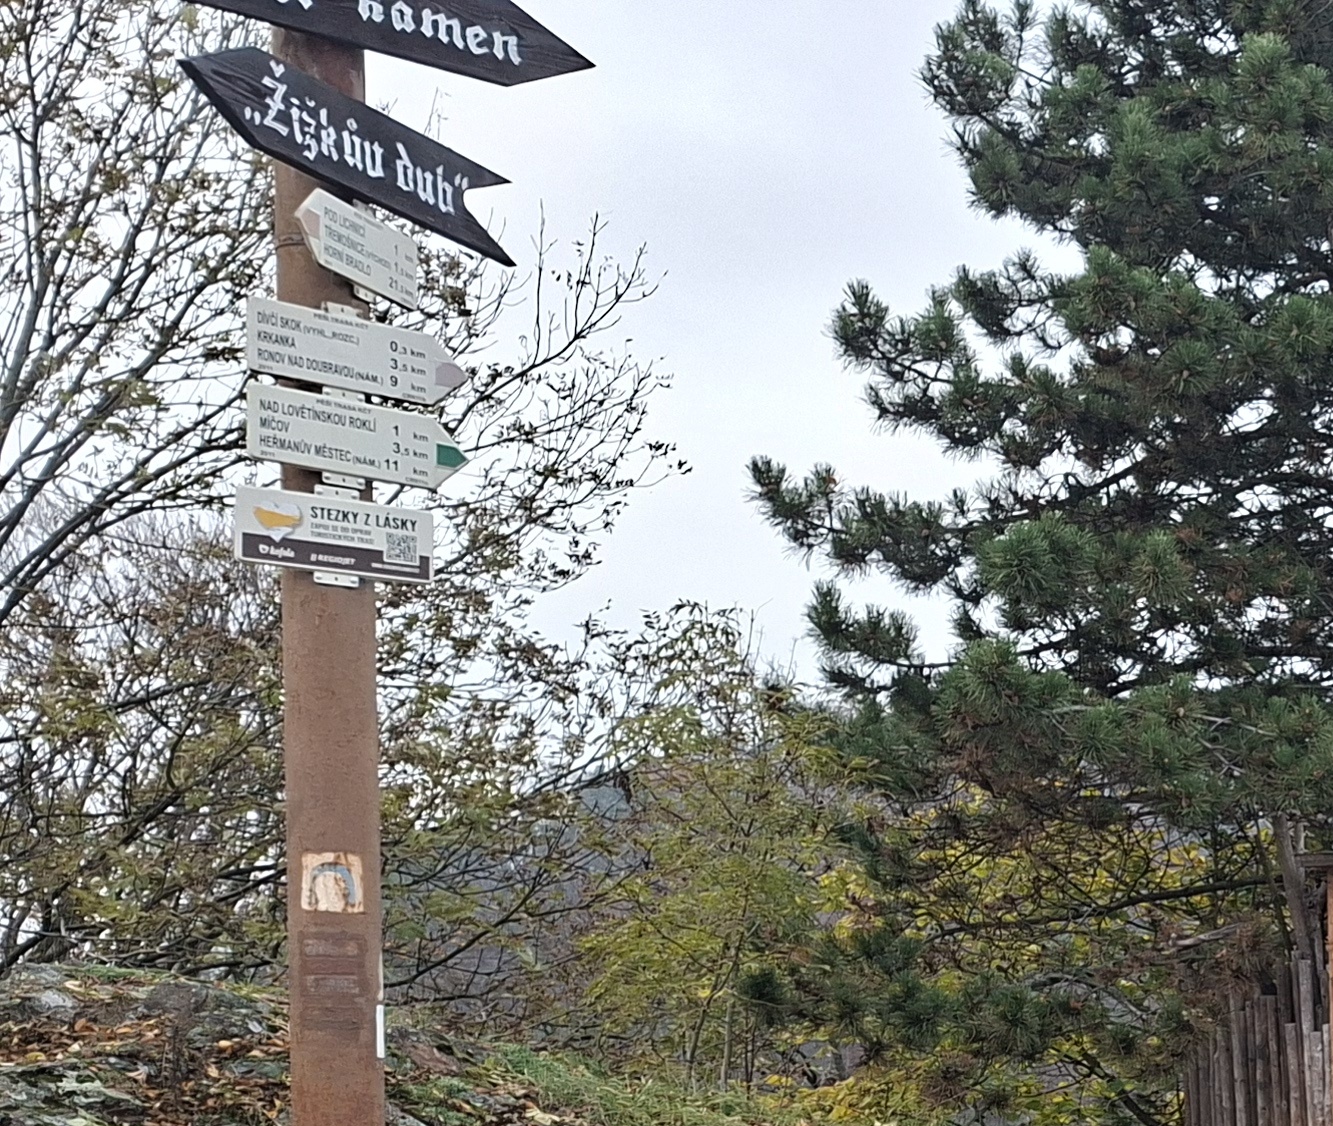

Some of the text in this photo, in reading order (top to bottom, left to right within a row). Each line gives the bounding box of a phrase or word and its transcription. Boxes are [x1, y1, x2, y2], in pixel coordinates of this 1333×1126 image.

[256, 330, 297, 349] KRKANKA
[279, 316, 302, 332] SKOK
[256, 347, 286, 365] RONOV
[287, 354, 305, 370] NAD
[305, 358, 355, 379] DOUBRAVOU
[389, 375, 398, 388] 9
[259, 400, 281, 416] NAD
[282, 403, 347, 428] LOVĚTÍNSKOU
[349, 415, 377, 433] ROKLÍ
[413, 432, 428, 443] km
[259, 416, 290, 434] MÍČOV
[413, 449, 428, 460] km
[259, 434, 312, 455] HEŘMANŮV
[314, 444, 352, 463] MĚSTEC
[384, 458, 399, 472] 11
[413, 468, 428, 478] km
[310, 506, 418, 533] STEZKY Z LÁSKY
